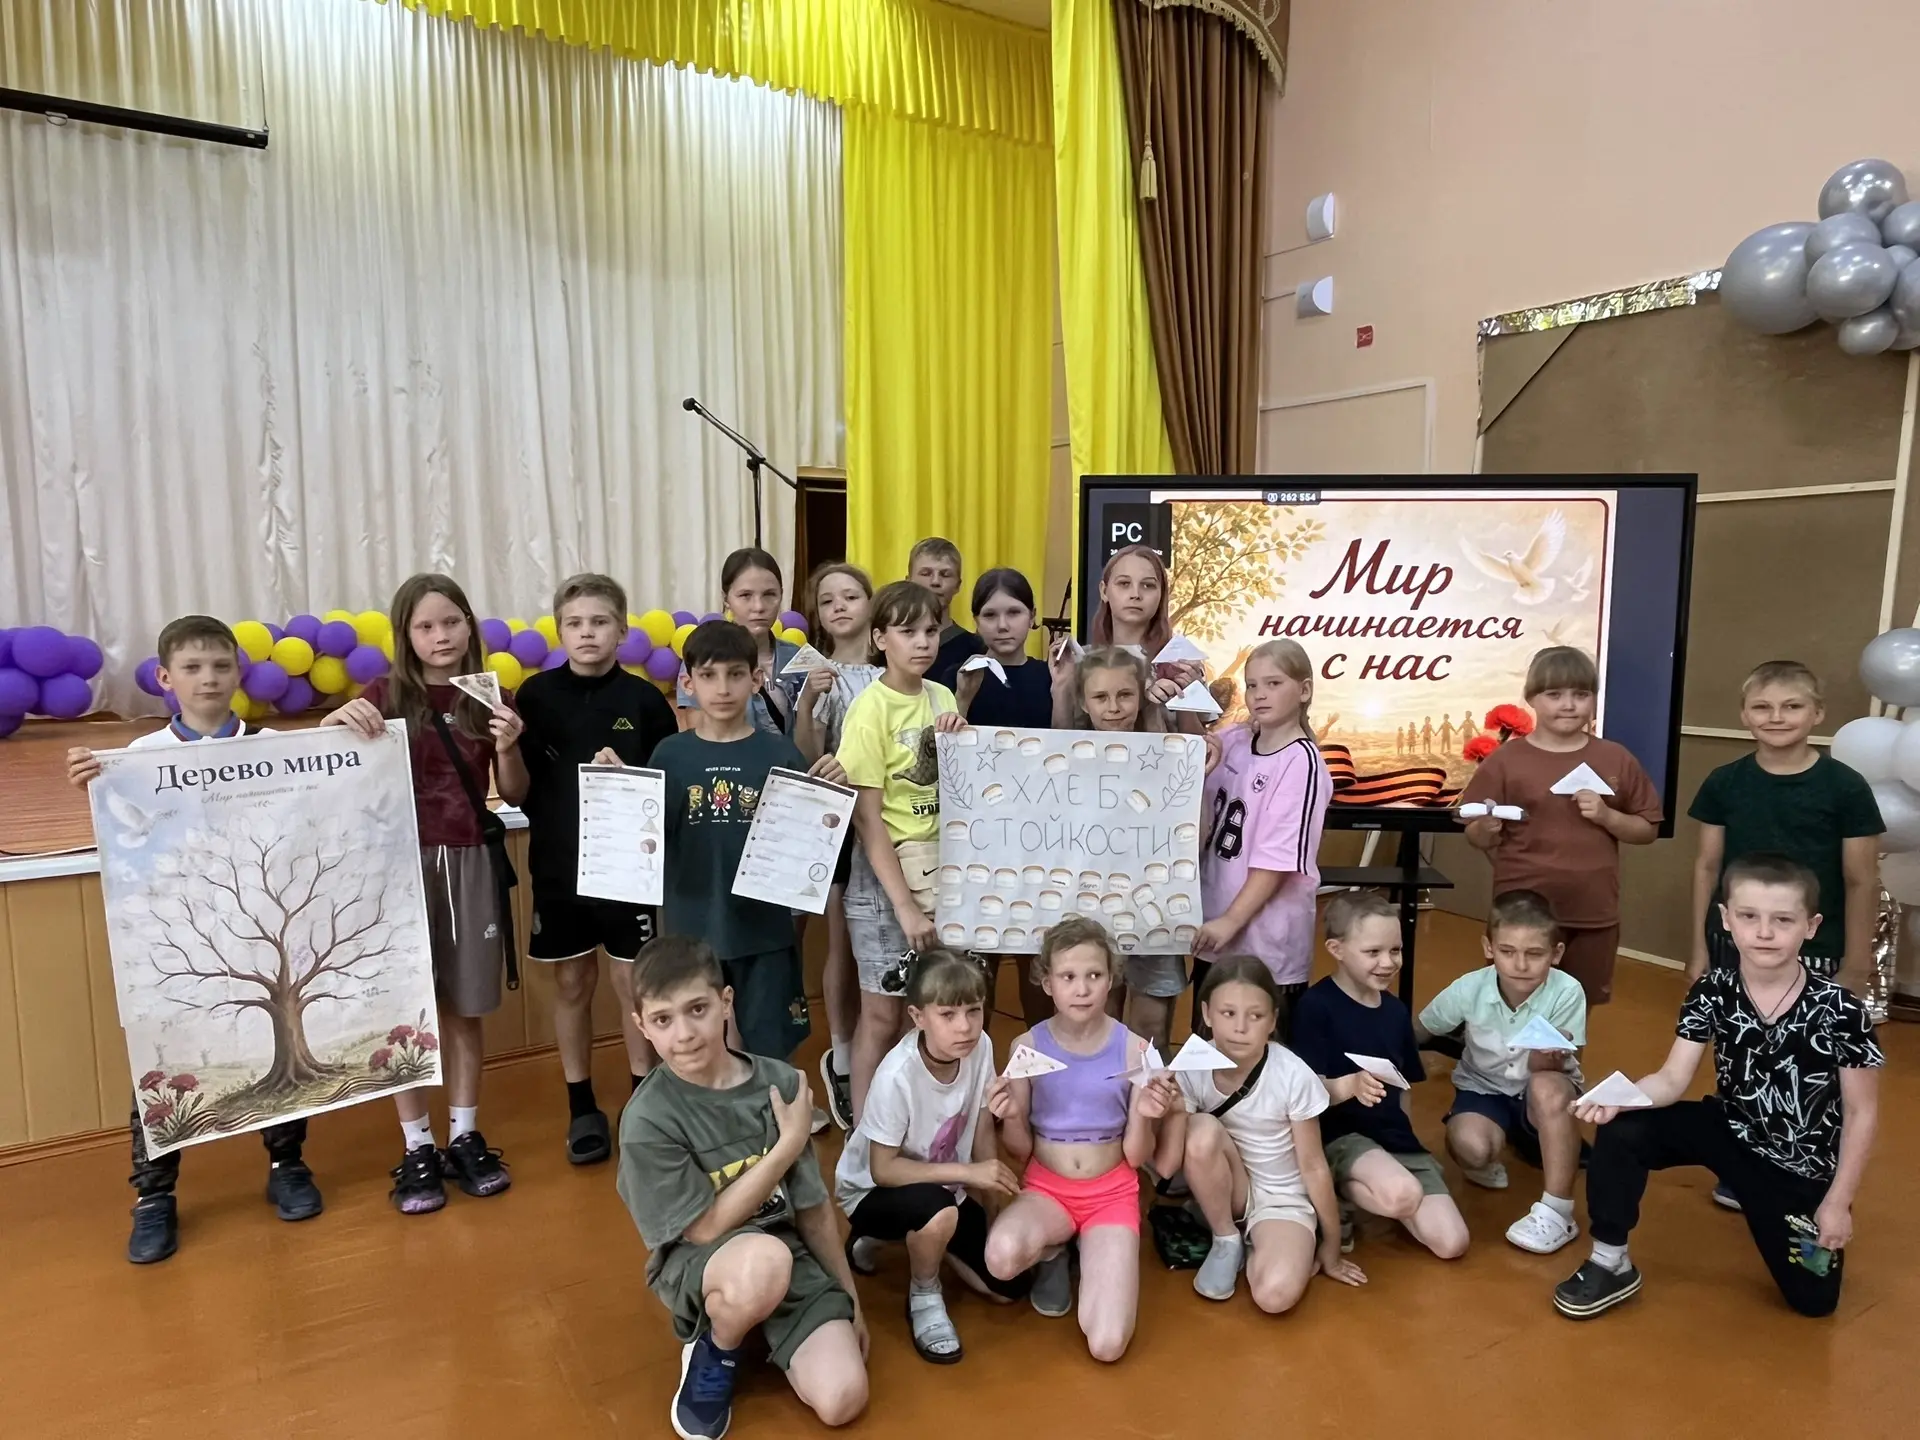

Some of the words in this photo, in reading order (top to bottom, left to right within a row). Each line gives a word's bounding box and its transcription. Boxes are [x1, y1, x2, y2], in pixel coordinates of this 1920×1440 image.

[1280, 492, 1298, 502] 262
[1299, 492, 1316, 502] 554
[1308, 537, 1454, 611] Мир
[1258, 614, 1525, 640] начинается
[1320, 653, 1348, 681] с
[1359, 653, 1453, 682] нас
[155, 760, 274, 796] Дерево
[283, 749, 362, 776] мира
[1011, 774, 1121, 810] ХЛЕБ
[969, 814, 1172, 858] СТОЙКОСТИ
